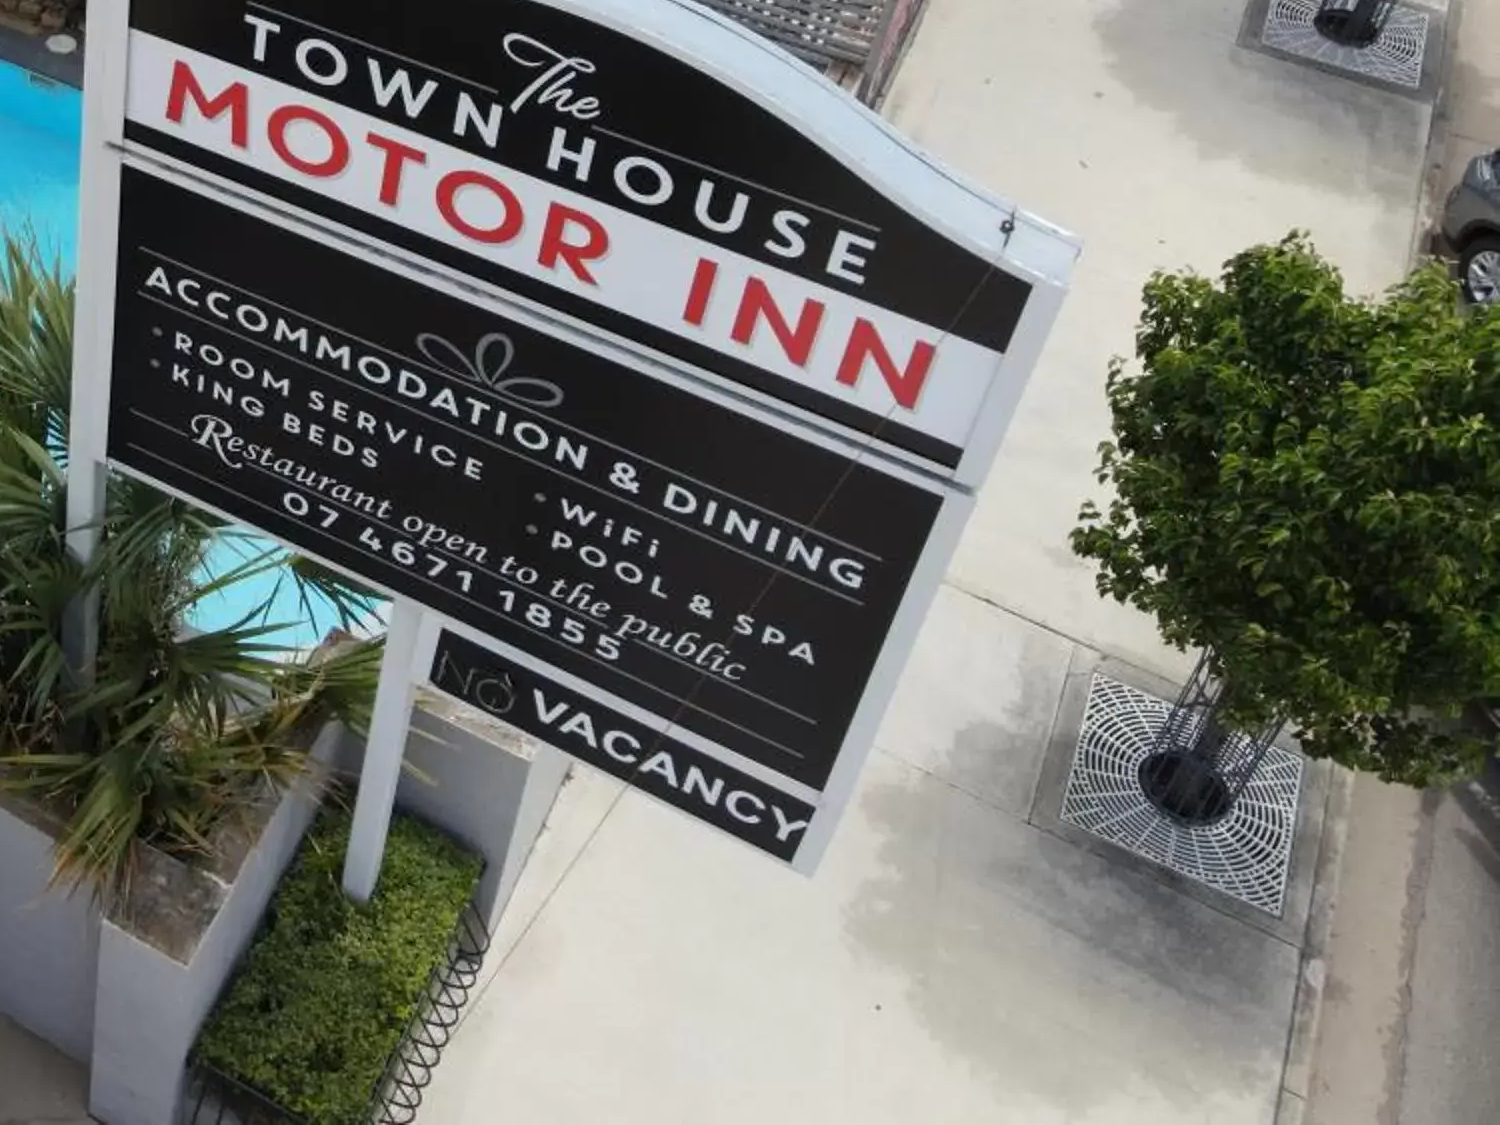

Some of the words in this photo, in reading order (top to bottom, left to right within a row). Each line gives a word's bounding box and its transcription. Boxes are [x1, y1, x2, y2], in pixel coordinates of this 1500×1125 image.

[244, 14, 503, 148] TOWN
[546, 126, 877, 285] HOUSE
[503, 33, 600, 120] The
[164, 60, 610, 286] MOTOR
[683, 257, 937, 410] INN
[145, 266, 588, 471] ACCOMMODATION
[608, 462, 640, 493] &
[663, 482, 866, 589] DINING
[172, 364, 265, 417] KING
[283, 412, 379, 468] BEDS
[175, 331, 290, 397] ROOM
[308, 390, 484, 481] SERVICE
[191, 414, 393, 519] Restaurant
[403, 515, 489, 564] open
[500, 555, 538, 585] to
[550, 574, 612, 618] the
[614, 613, 747, 681] public
[283, 492, 340, 528] 07
[358, 527, 474, 593] 4671
[500, 590, 621, 661] 1855
[551, 530, 668, 599] POOL
[688, 594, 714, 619] &
[733, 614, 815, 665] SPA
[533, 689, 807, 842] VACANCY
